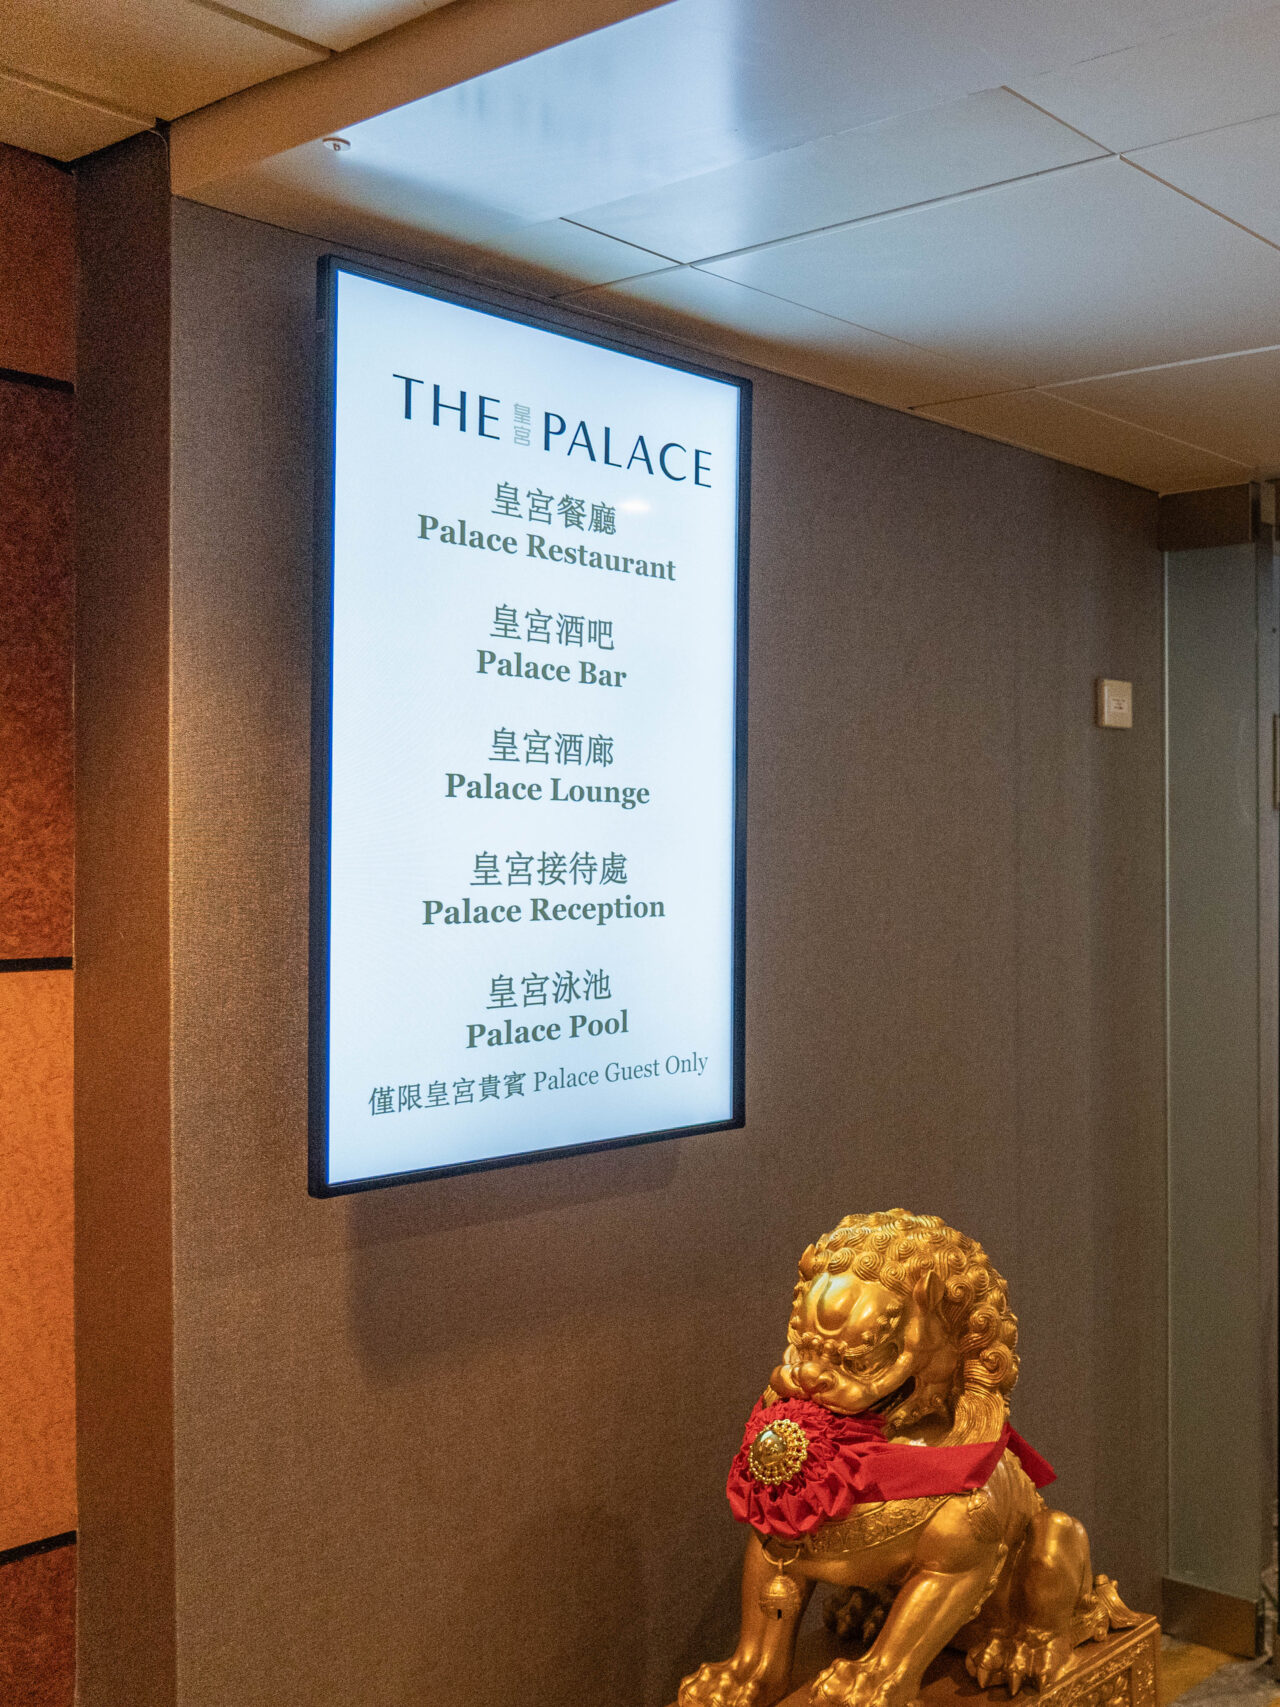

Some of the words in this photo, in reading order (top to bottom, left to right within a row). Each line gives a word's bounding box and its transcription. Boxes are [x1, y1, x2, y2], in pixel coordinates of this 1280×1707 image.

[392, 373, 501, 440] THE
[544, 411, 712, 488] PALACE
[513, 403, 531, 447] 皇宮
[491, 481, 617, 536] 皇宮餐廳
[417, 513, 518, 555] Palace
[526, 533, 677, 581] Restaurant
[489, 603, 615, 650] 皇宮酒吧
[476, 649, 571, 683] Palace
[578, 661, 627, 688] Bar
[488, 726, 614, 768] 皇宮酒廊
[445, 773, 542, 801] Palace
[550, 778, 651, 810] Lounge
[469, 850, 628, 887] 皇宮接待處
[422, 898, 522, 926] Palace
[529, 894, 666, 926] Reception
[486, 968, 612, 1010] 皇宮泳池
[465, 1019, 561, 1049] Palace
[568, 1008, 630, 1038] Pool
[368, 1070, 527, 1116] 僅限皇宮貴賓
[533, 1068, 599, 1092] Palace
[604, 1058, 660, 1083] Guest
[665, 1051, 709, 1076] Only
